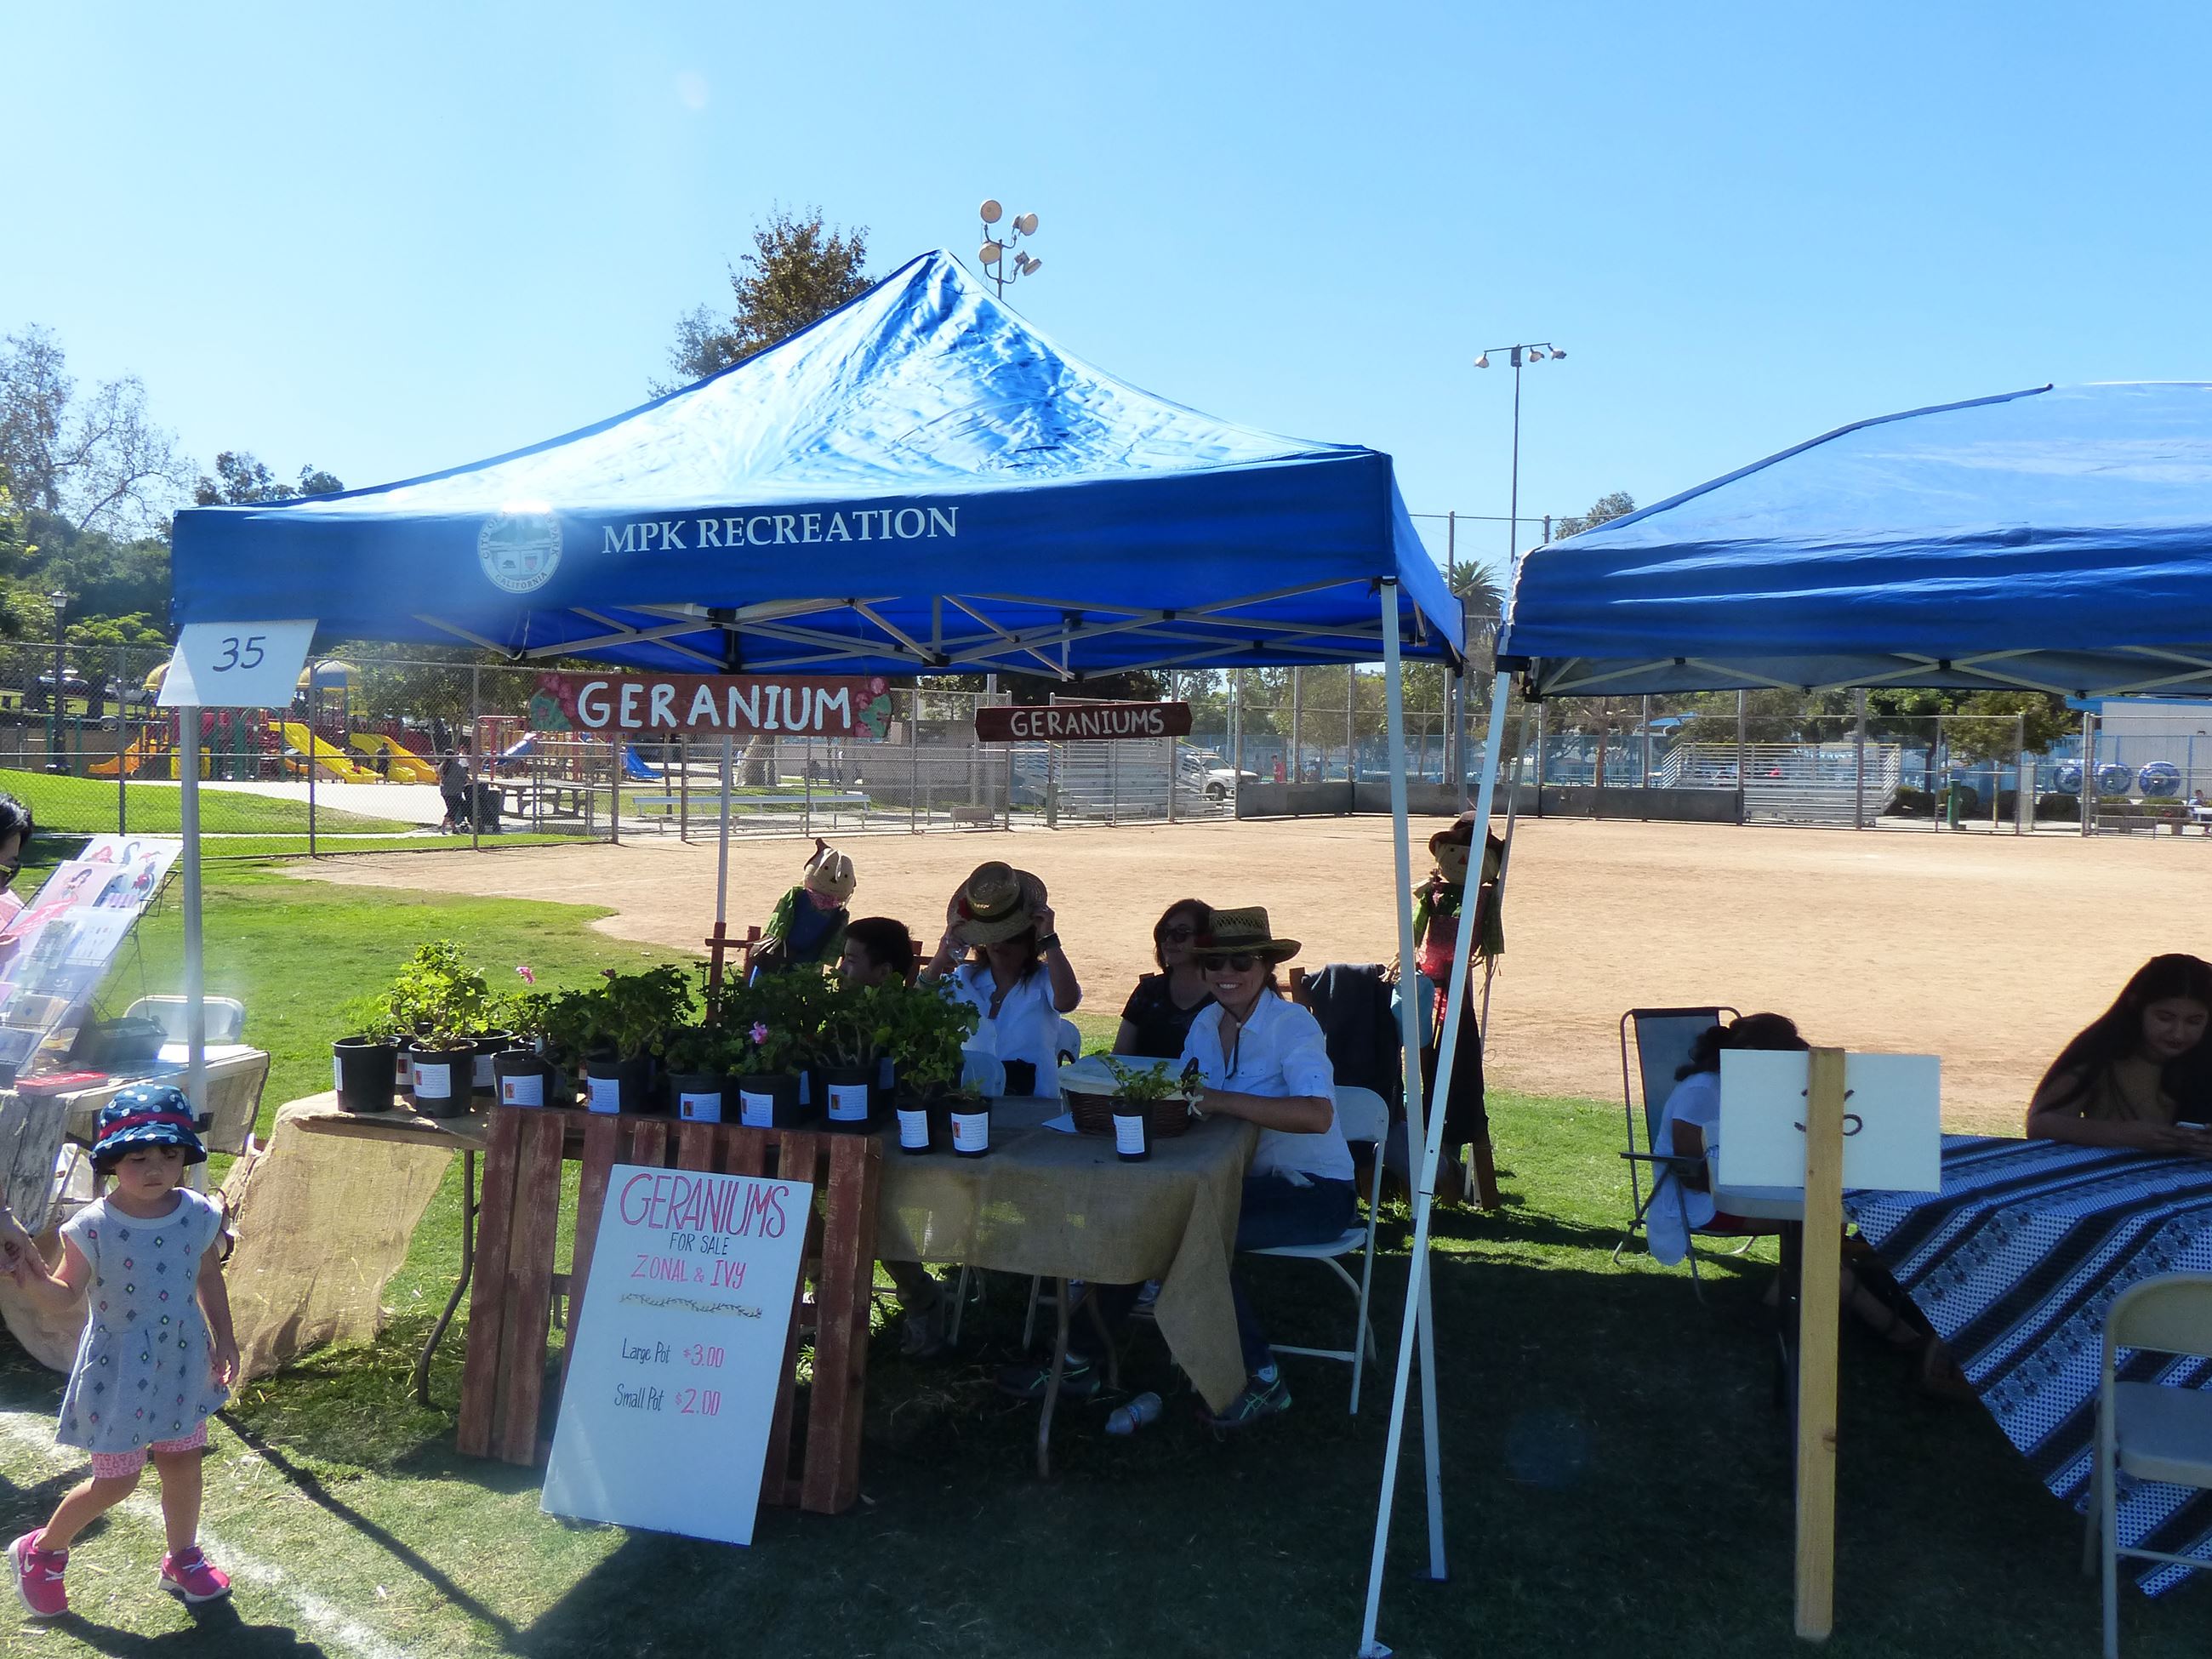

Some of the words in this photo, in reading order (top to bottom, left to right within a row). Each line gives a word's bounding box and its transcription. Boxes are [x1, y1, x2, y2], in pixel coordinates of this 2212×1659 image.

[481, 532, 490, 559] CITY
[601, 521, 687, 554] MPK
[697, 506, 960, 549] RECREATION
[495, 572, 548, 590] CALIFORNIA
[212, 636, 266, 672] 35
[578, 681, 852, 731] GERANIUM
[1010, 708, 1165, 737] GERANIUMS
[620, 1173, 790, 1239] GERANIUMS
[669, 1232, 696, 1252] FOR
[700, 1235, 730, 1256] SALE
[631, 1254, 688, 1283] ZONAL
[693, 1267, 704, 1284] &
[710, 1259, 747, 1290] IVY
[622, 1337, 652, 1365] Large
[654, 1341, 671, 1364] Pot
[683, 1343, 725, 1368] $3.00
[614, 1382, 647, 1409] Small
[647, 1386, 664, 1411] Pot
[675, 1388, 721, 1417] $2.00
